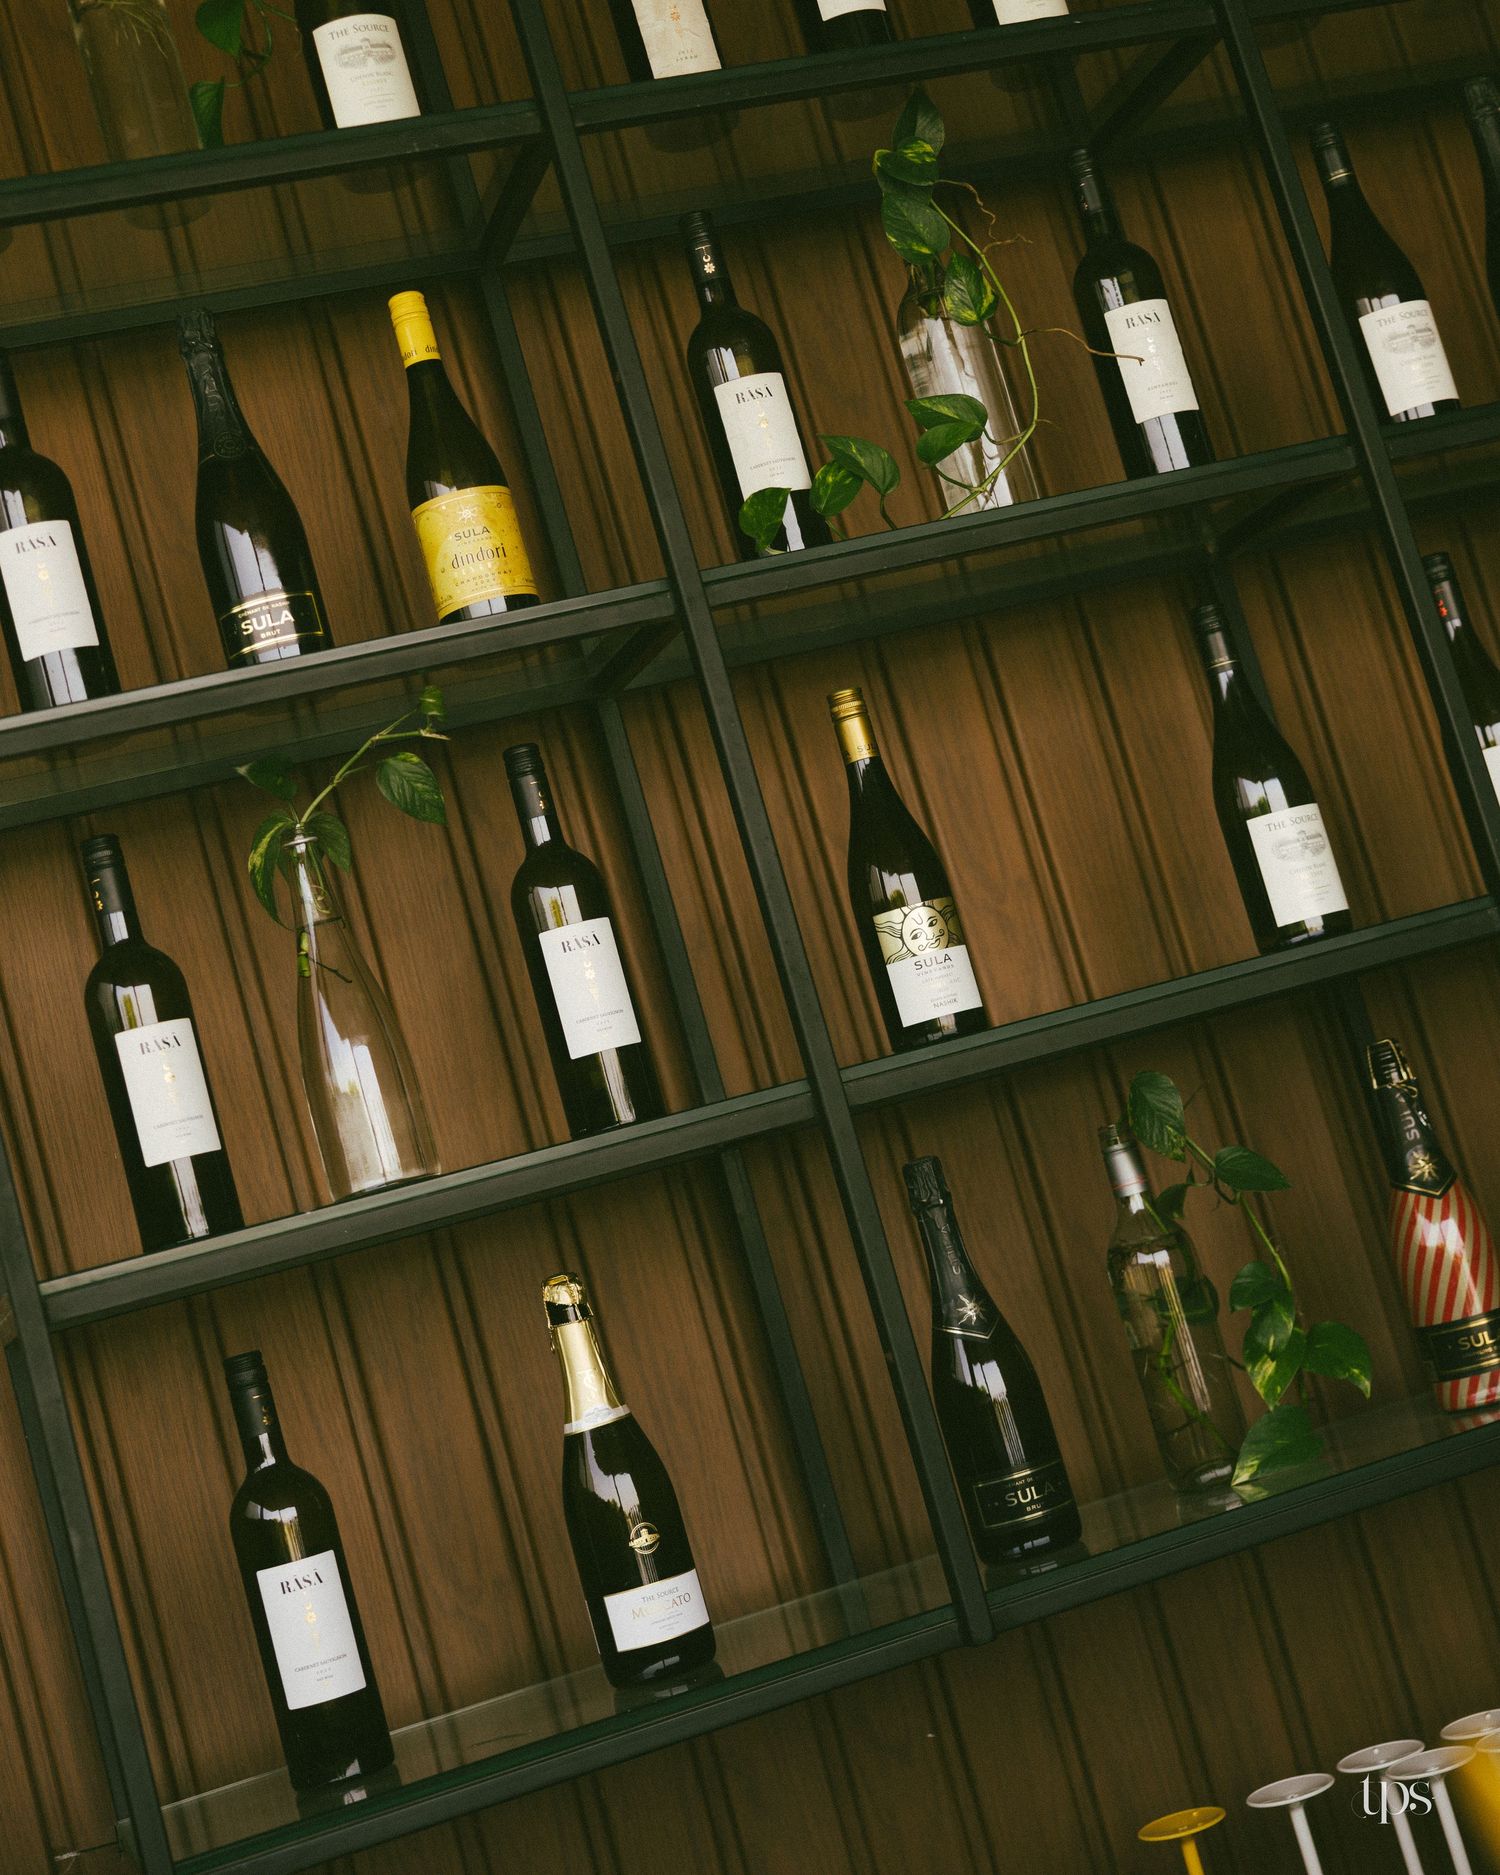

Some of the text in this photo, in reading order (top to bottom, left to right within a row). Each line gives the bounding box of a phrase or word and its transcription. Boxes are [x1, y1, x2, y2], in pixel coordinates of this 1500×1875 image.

[328, 23, 391, 41] THE SOURCE
[454, 526, 491, 542] SULA
[451, 542, 507, 570] dindori
[241, 609, 295, 636] SULA
[260, 628, 281, 639] BRUT
[1265, 820, 1286, 832] THE
[914, 953, 953, 971] SULA
[933, 998, 959, 1009] NASHIK
[1458, 1330, 1499, 1350] SUL
[1004, 1481, 1056, 1507] SULA
[1026, 1502, 1043, 1512] BRU
[641, 1586, 679, 1603] THE SOURCE
